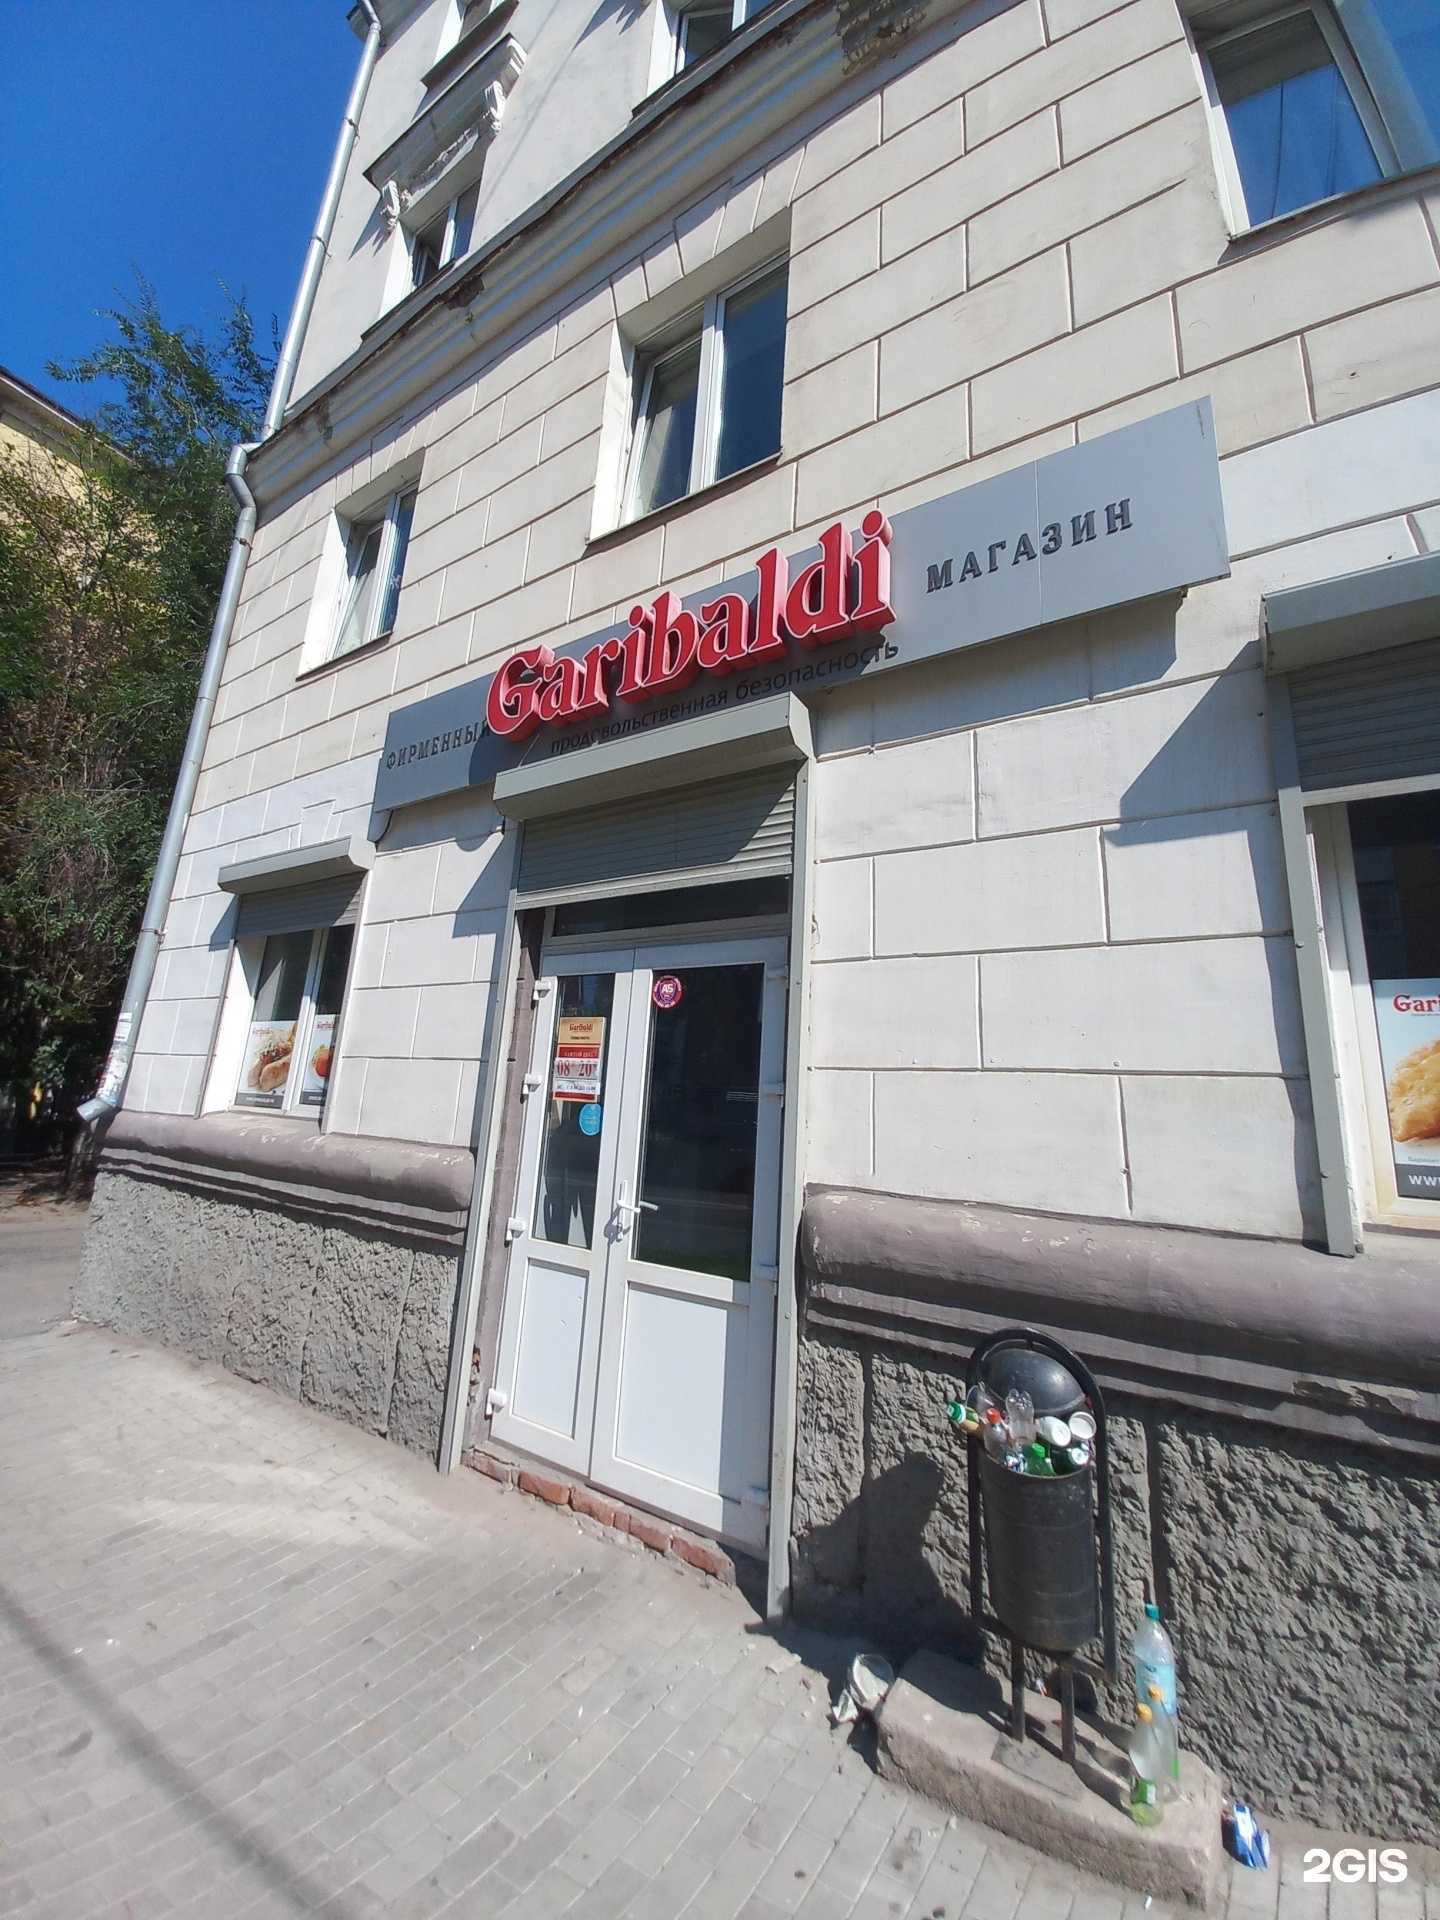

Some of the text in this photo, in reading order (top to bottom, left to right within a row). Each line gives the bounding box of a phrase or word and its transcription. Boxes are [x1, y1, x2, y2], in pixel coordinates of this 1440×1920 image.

[486, 510, 895, 738] Garibaldi
[926, 498, 1133, 593] МАГАЗИН
[735, 641, 899, 700] безопасность
